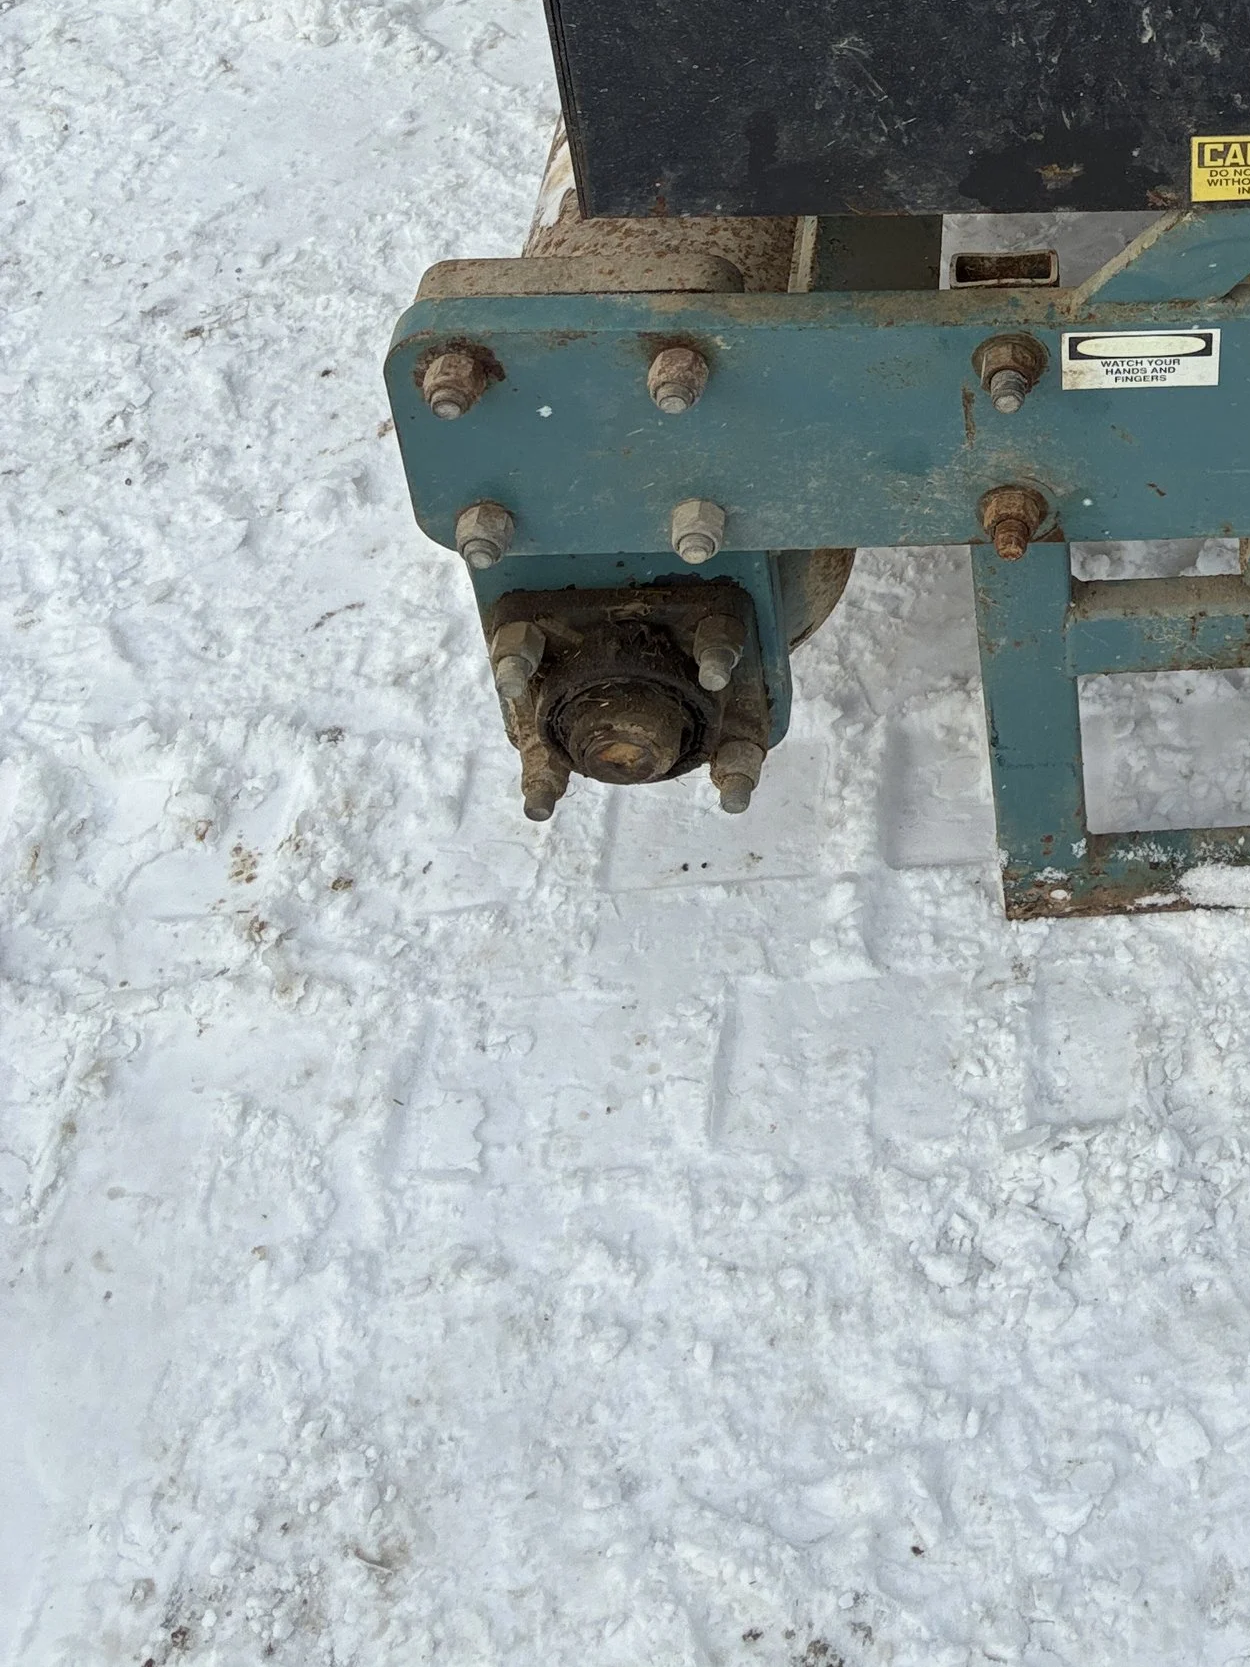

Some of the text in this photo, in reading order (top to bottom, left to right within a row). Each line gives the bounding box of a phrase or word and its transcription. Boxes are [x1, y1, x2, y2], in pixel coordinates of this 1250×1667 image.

[1209, 169, 1229, 178] DO
[1238, 186, 1250, 195] IN
[1101, 358, 1181, 368] WATCH YOUR
[1105, 366, 1176, 376] HANDS AND
[1115, 375, 1167, 383] FINGERS
